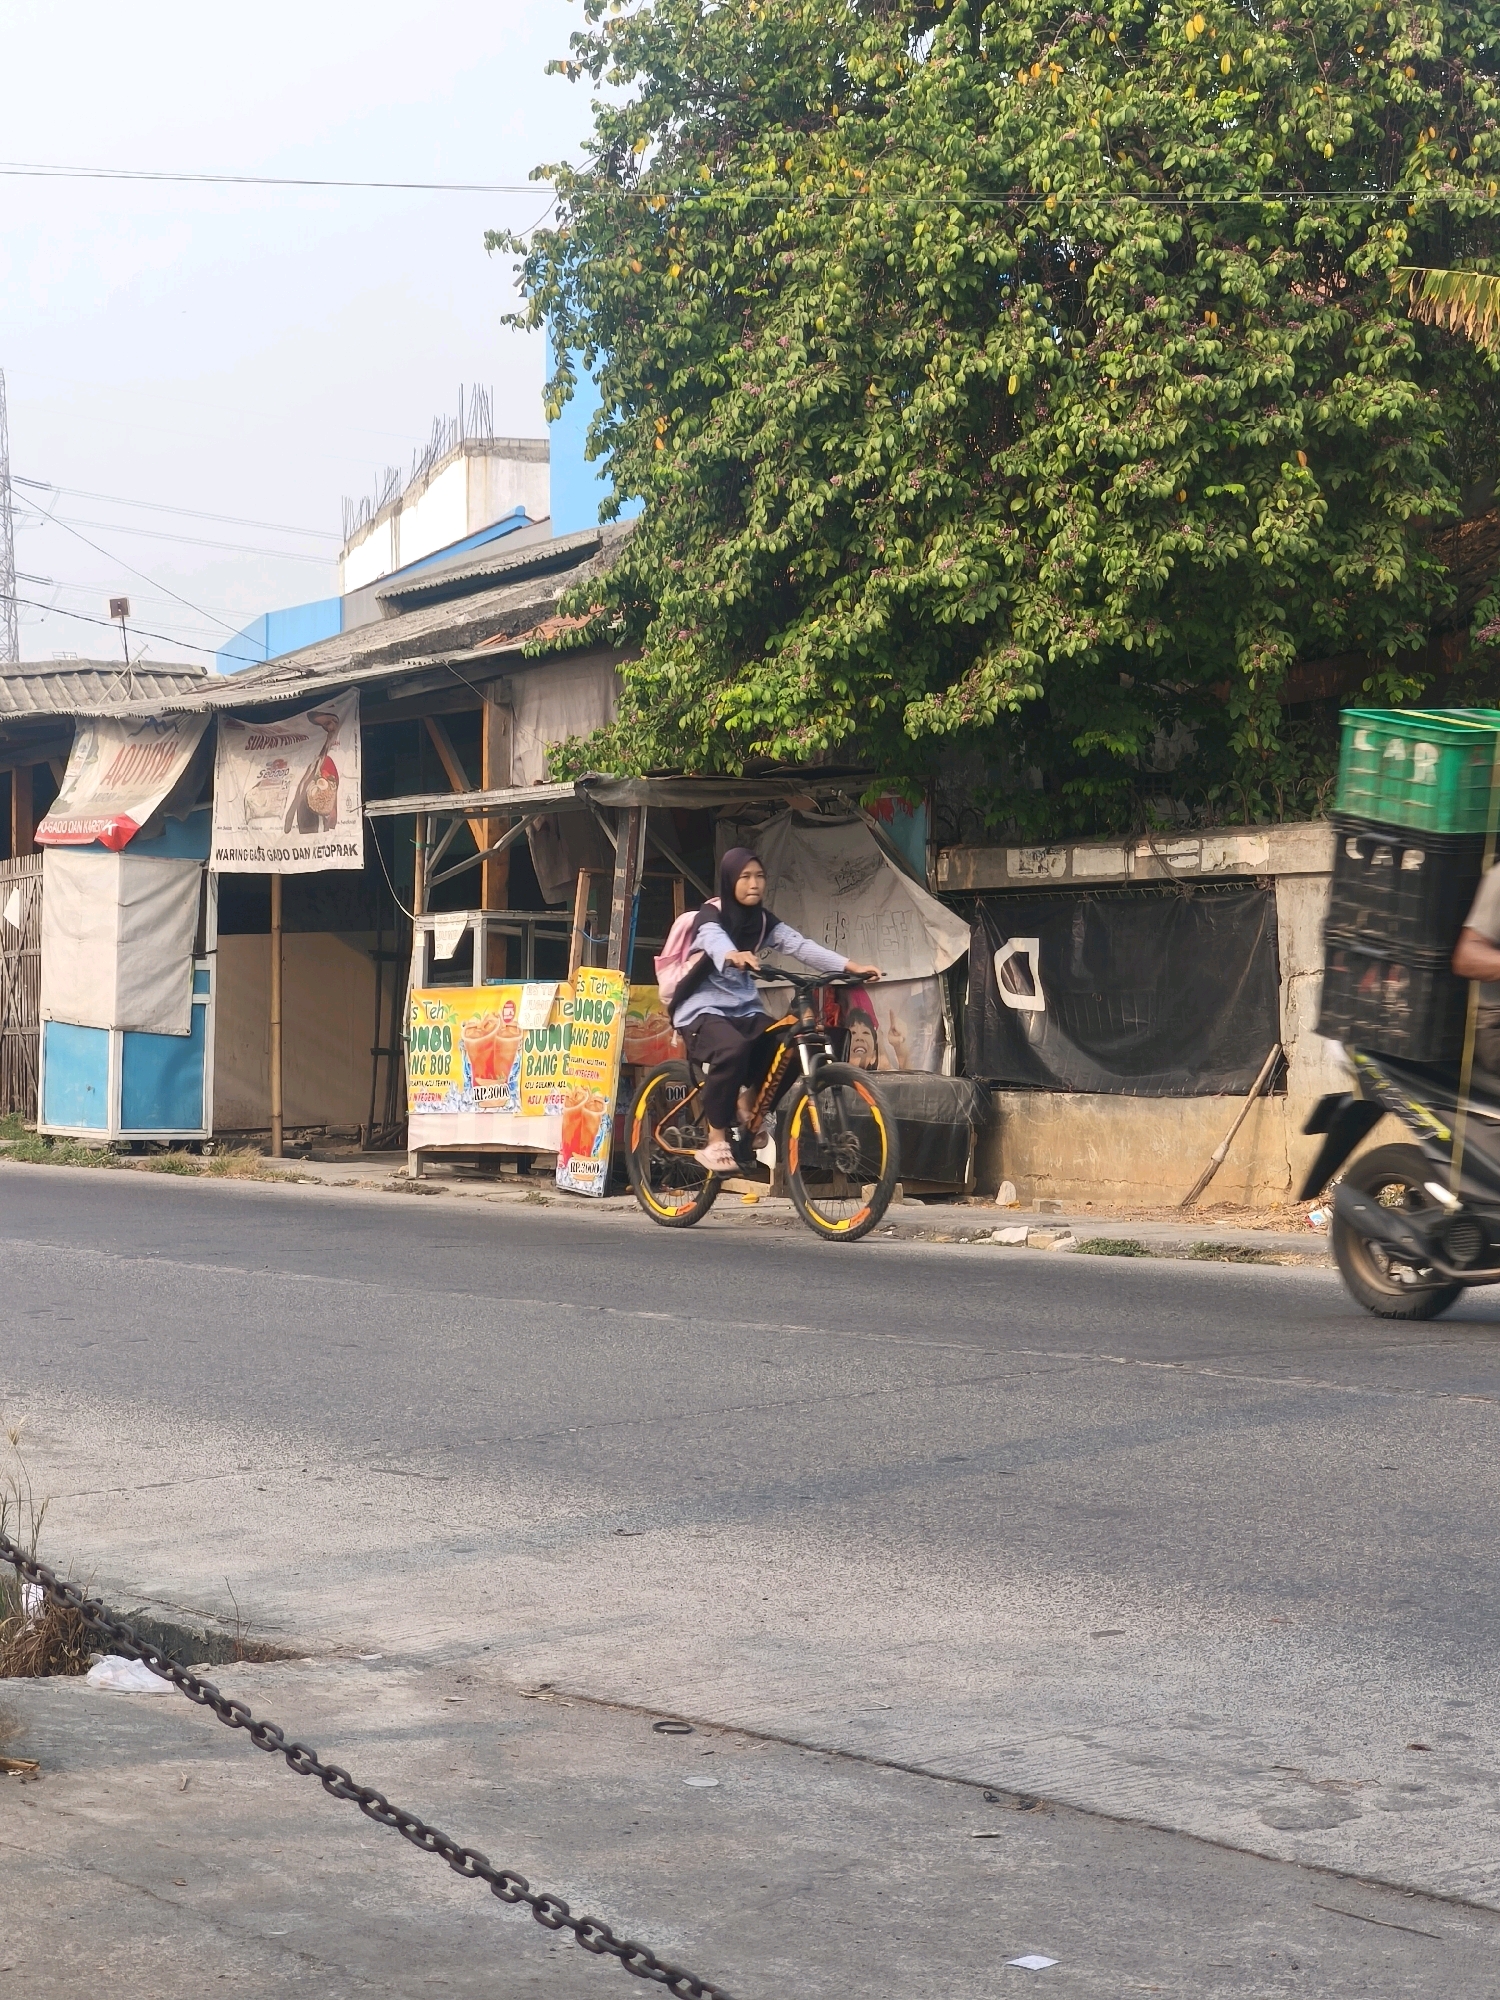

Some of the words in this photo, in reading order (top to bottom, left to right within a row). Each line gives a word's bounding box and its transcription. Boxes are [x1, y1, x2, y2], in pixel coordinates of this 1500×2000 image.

[267, 848, 290, 861] GADO
[292, 847, 310, 860] DAN
[312, 843, 358, 858] KETOPRAK
[590, 976, 607, 995] Teh
[423, 1000, 444, 1020] Teh
[555, 997, 573, 1016] Te
[574, 997, 615, 1025] UMBO
[571, 1028, 589, 1047] ANG
[526, 1053, 558, 1076] BANG
